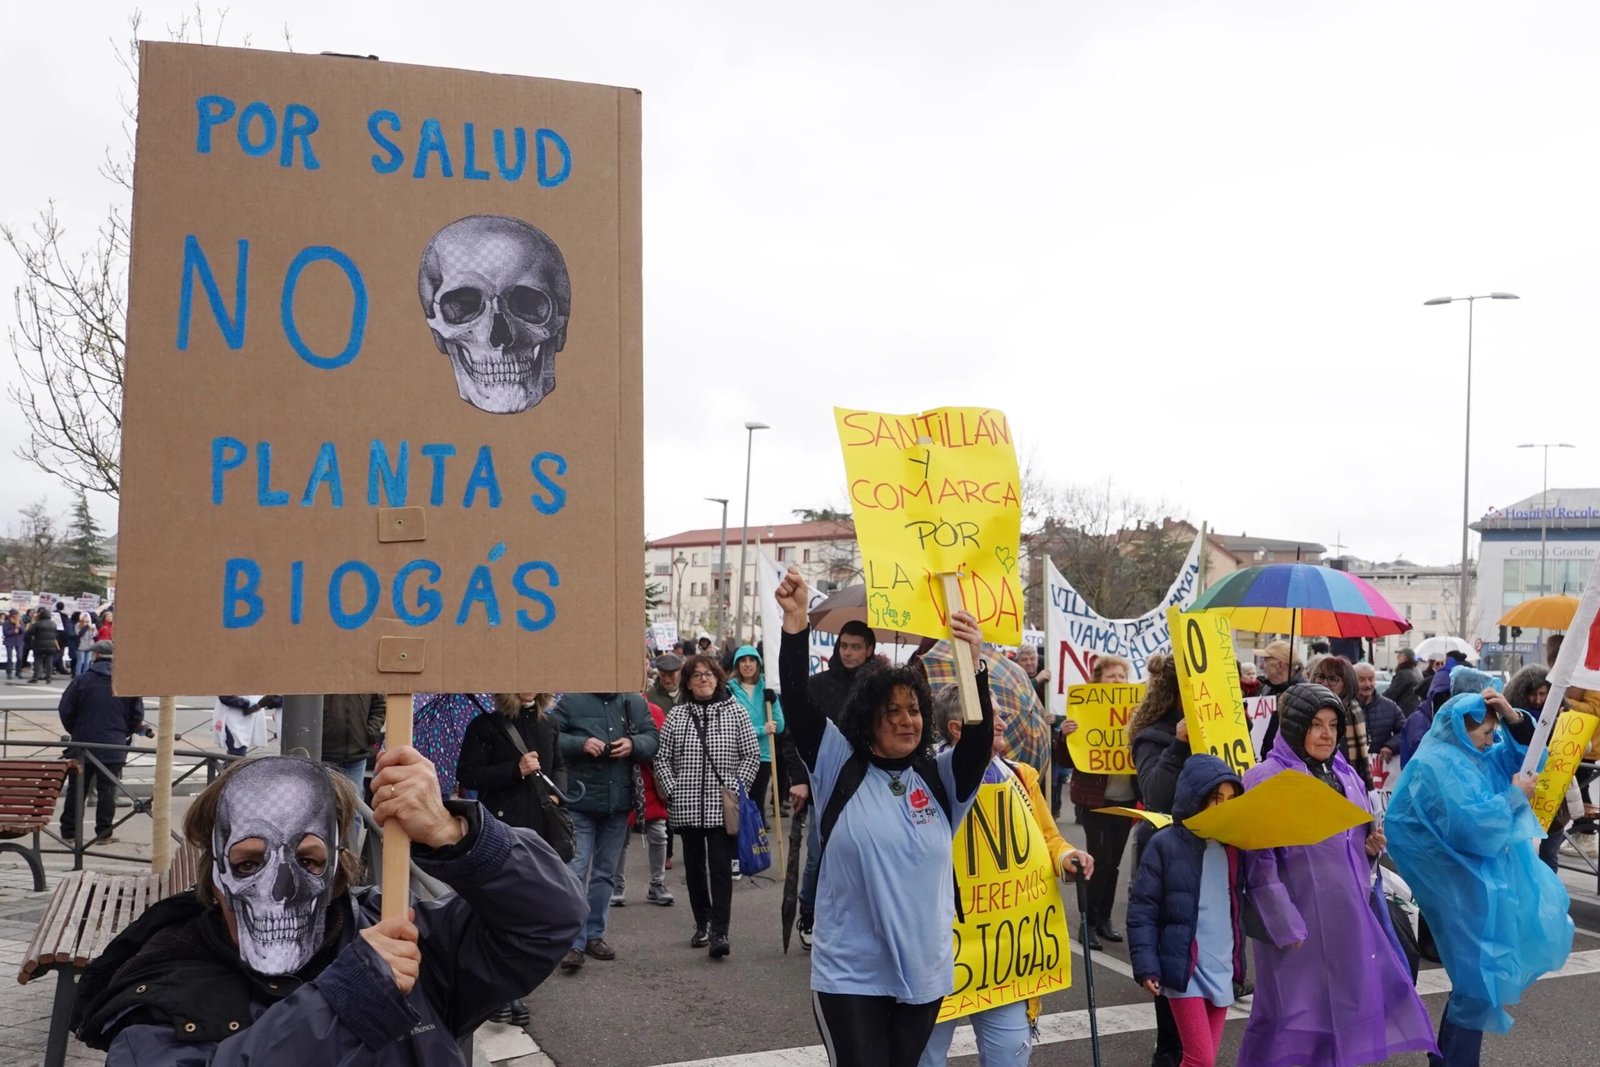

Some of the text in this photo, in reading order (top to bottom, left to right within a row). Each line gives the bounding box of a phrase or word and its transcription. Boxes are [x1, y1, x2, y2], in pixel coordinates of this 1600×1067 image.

[196, 95, 572, 187] POR SALUD
[176, 234, 369, 370] NO
[211, 436, 567, 515] PLANTAS
[908, 449, 931, 479] Y
[851, 478, 1019, 510] COMARCA
[1505, 507, 1555, 521] Hospial
[904, 519, 980, 550] POR
[1553, 546, 1595, 557] Grande
[223, 543, 560, 632] BIOGÁS
[870, 560, 914, 591] LA
[964, 786, 1030, 878] NO
[955, 865, 1048, 918] UEREMOS
